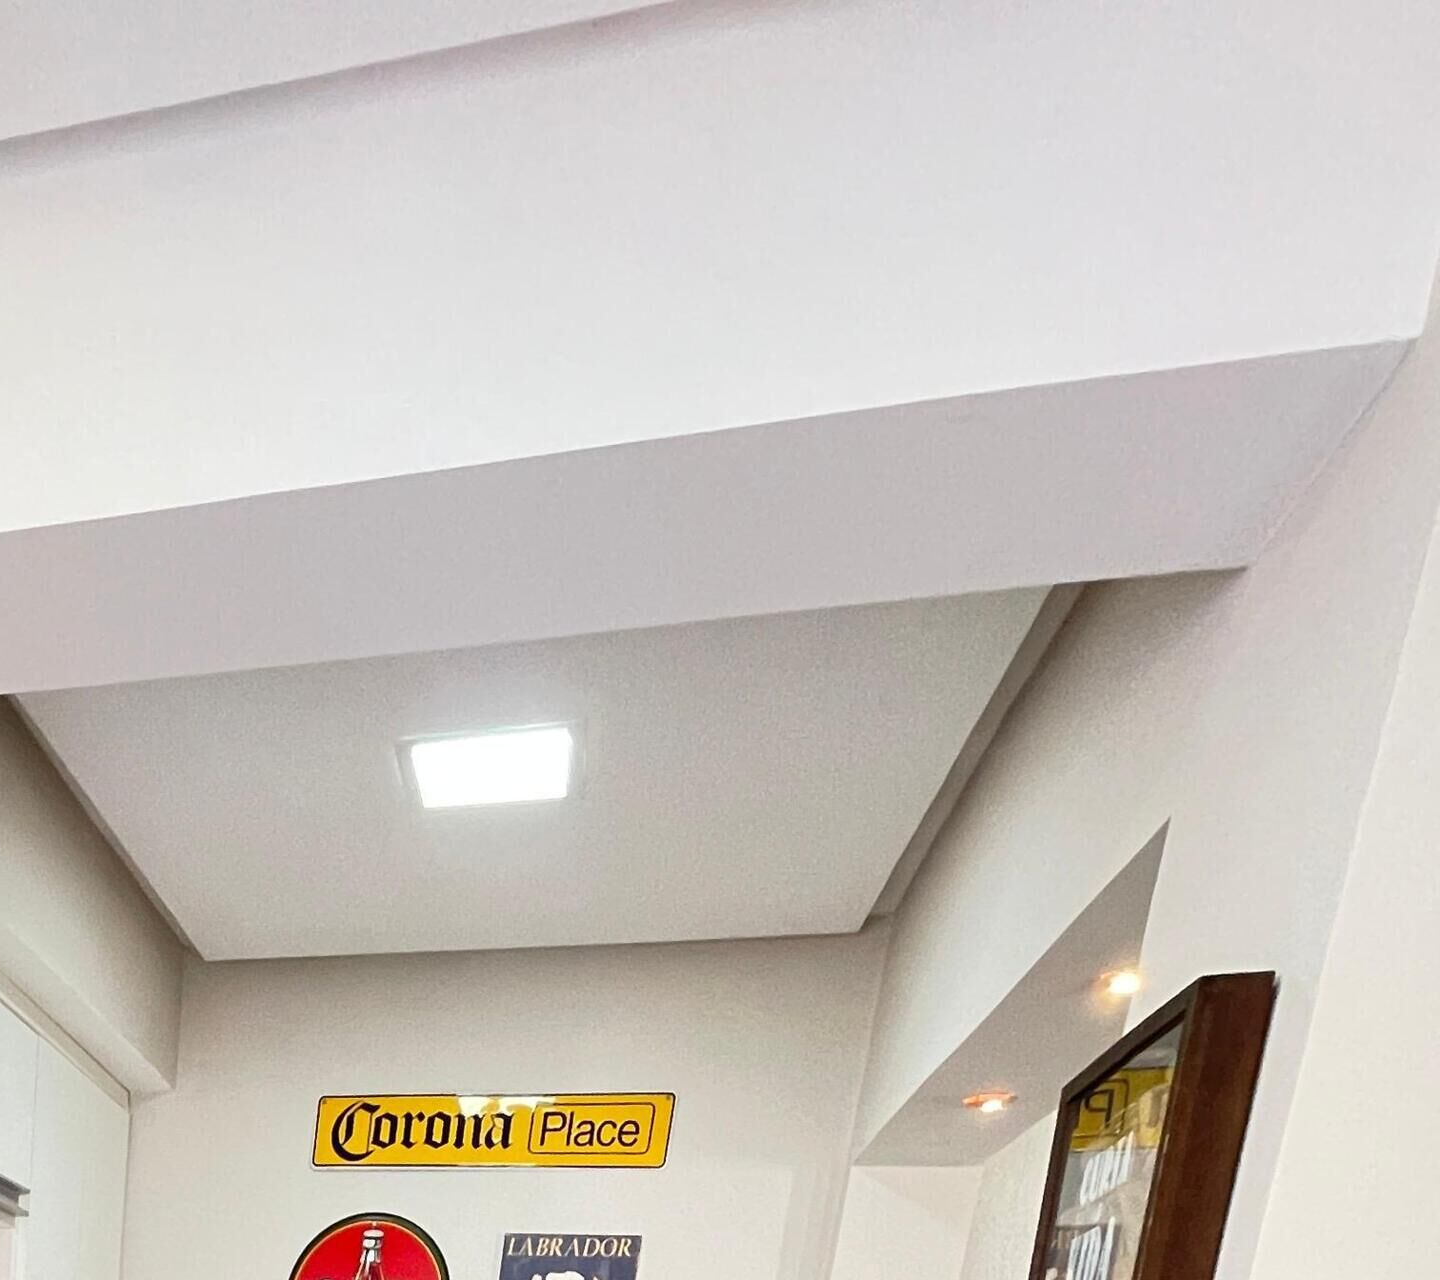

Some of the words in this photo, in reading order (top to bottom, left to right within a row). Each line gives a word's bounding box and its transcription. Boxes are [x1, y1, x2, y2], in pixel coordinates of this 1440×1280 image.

[331, 1101, 512, 1162] Corona
[539, 1111, 640, 1147] Place
[507, 1237, 632, 1257] LABRADOR
